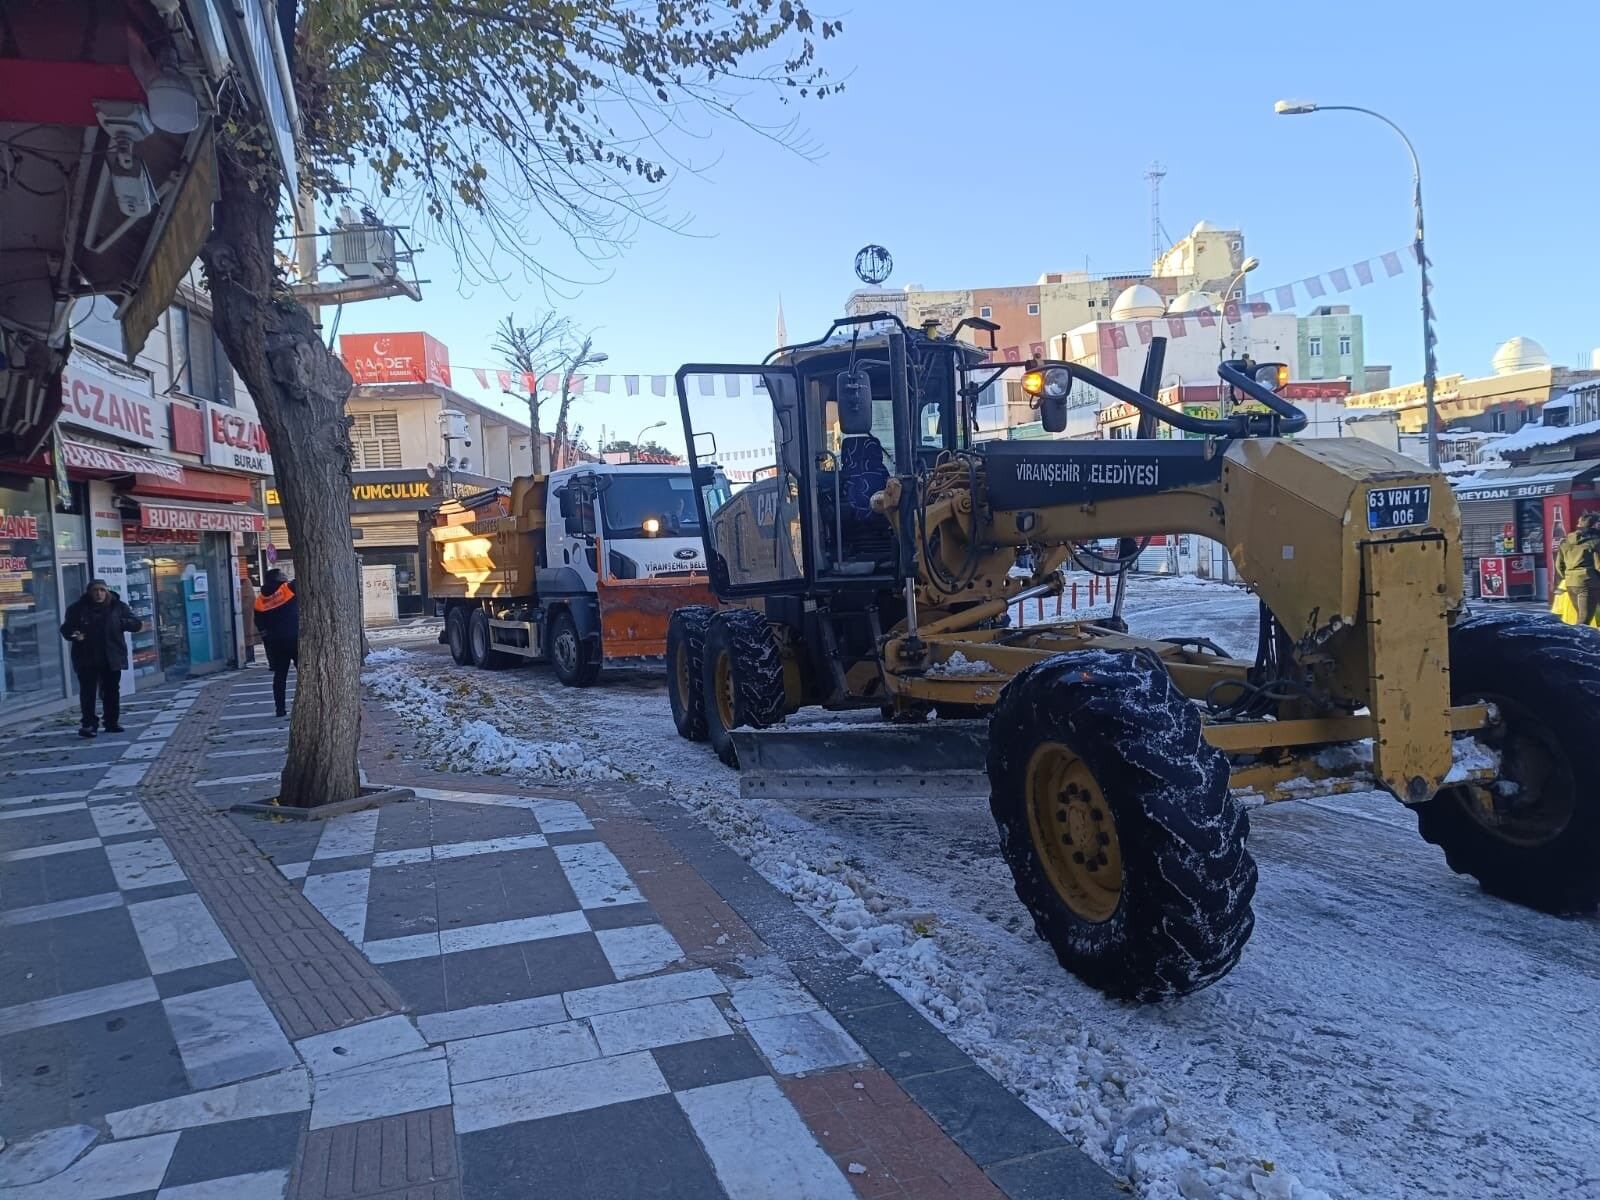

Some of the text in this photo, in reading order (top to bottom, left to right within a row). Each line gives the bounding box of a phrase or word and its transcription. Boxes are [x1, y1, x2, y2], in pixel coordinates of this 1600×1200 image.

[234, 454, 263, 470] BURAK
[1016, 458, 1159, 487] VİRANŞEHİR ELEDİYESİ
[352, 482, 430, 500] YUMCULUK
[1369, 488, 1428, 507] 63 VRN 11
[1457, 484, 1555, 501] MEYDAN BÜFE
[758, 491, 778, 526] CAT
[1392, 509, 1414, 525] 006
[149, 508, 255, 532] BURAK ECZANESİ
[690, 561, 706, 569] BELE
